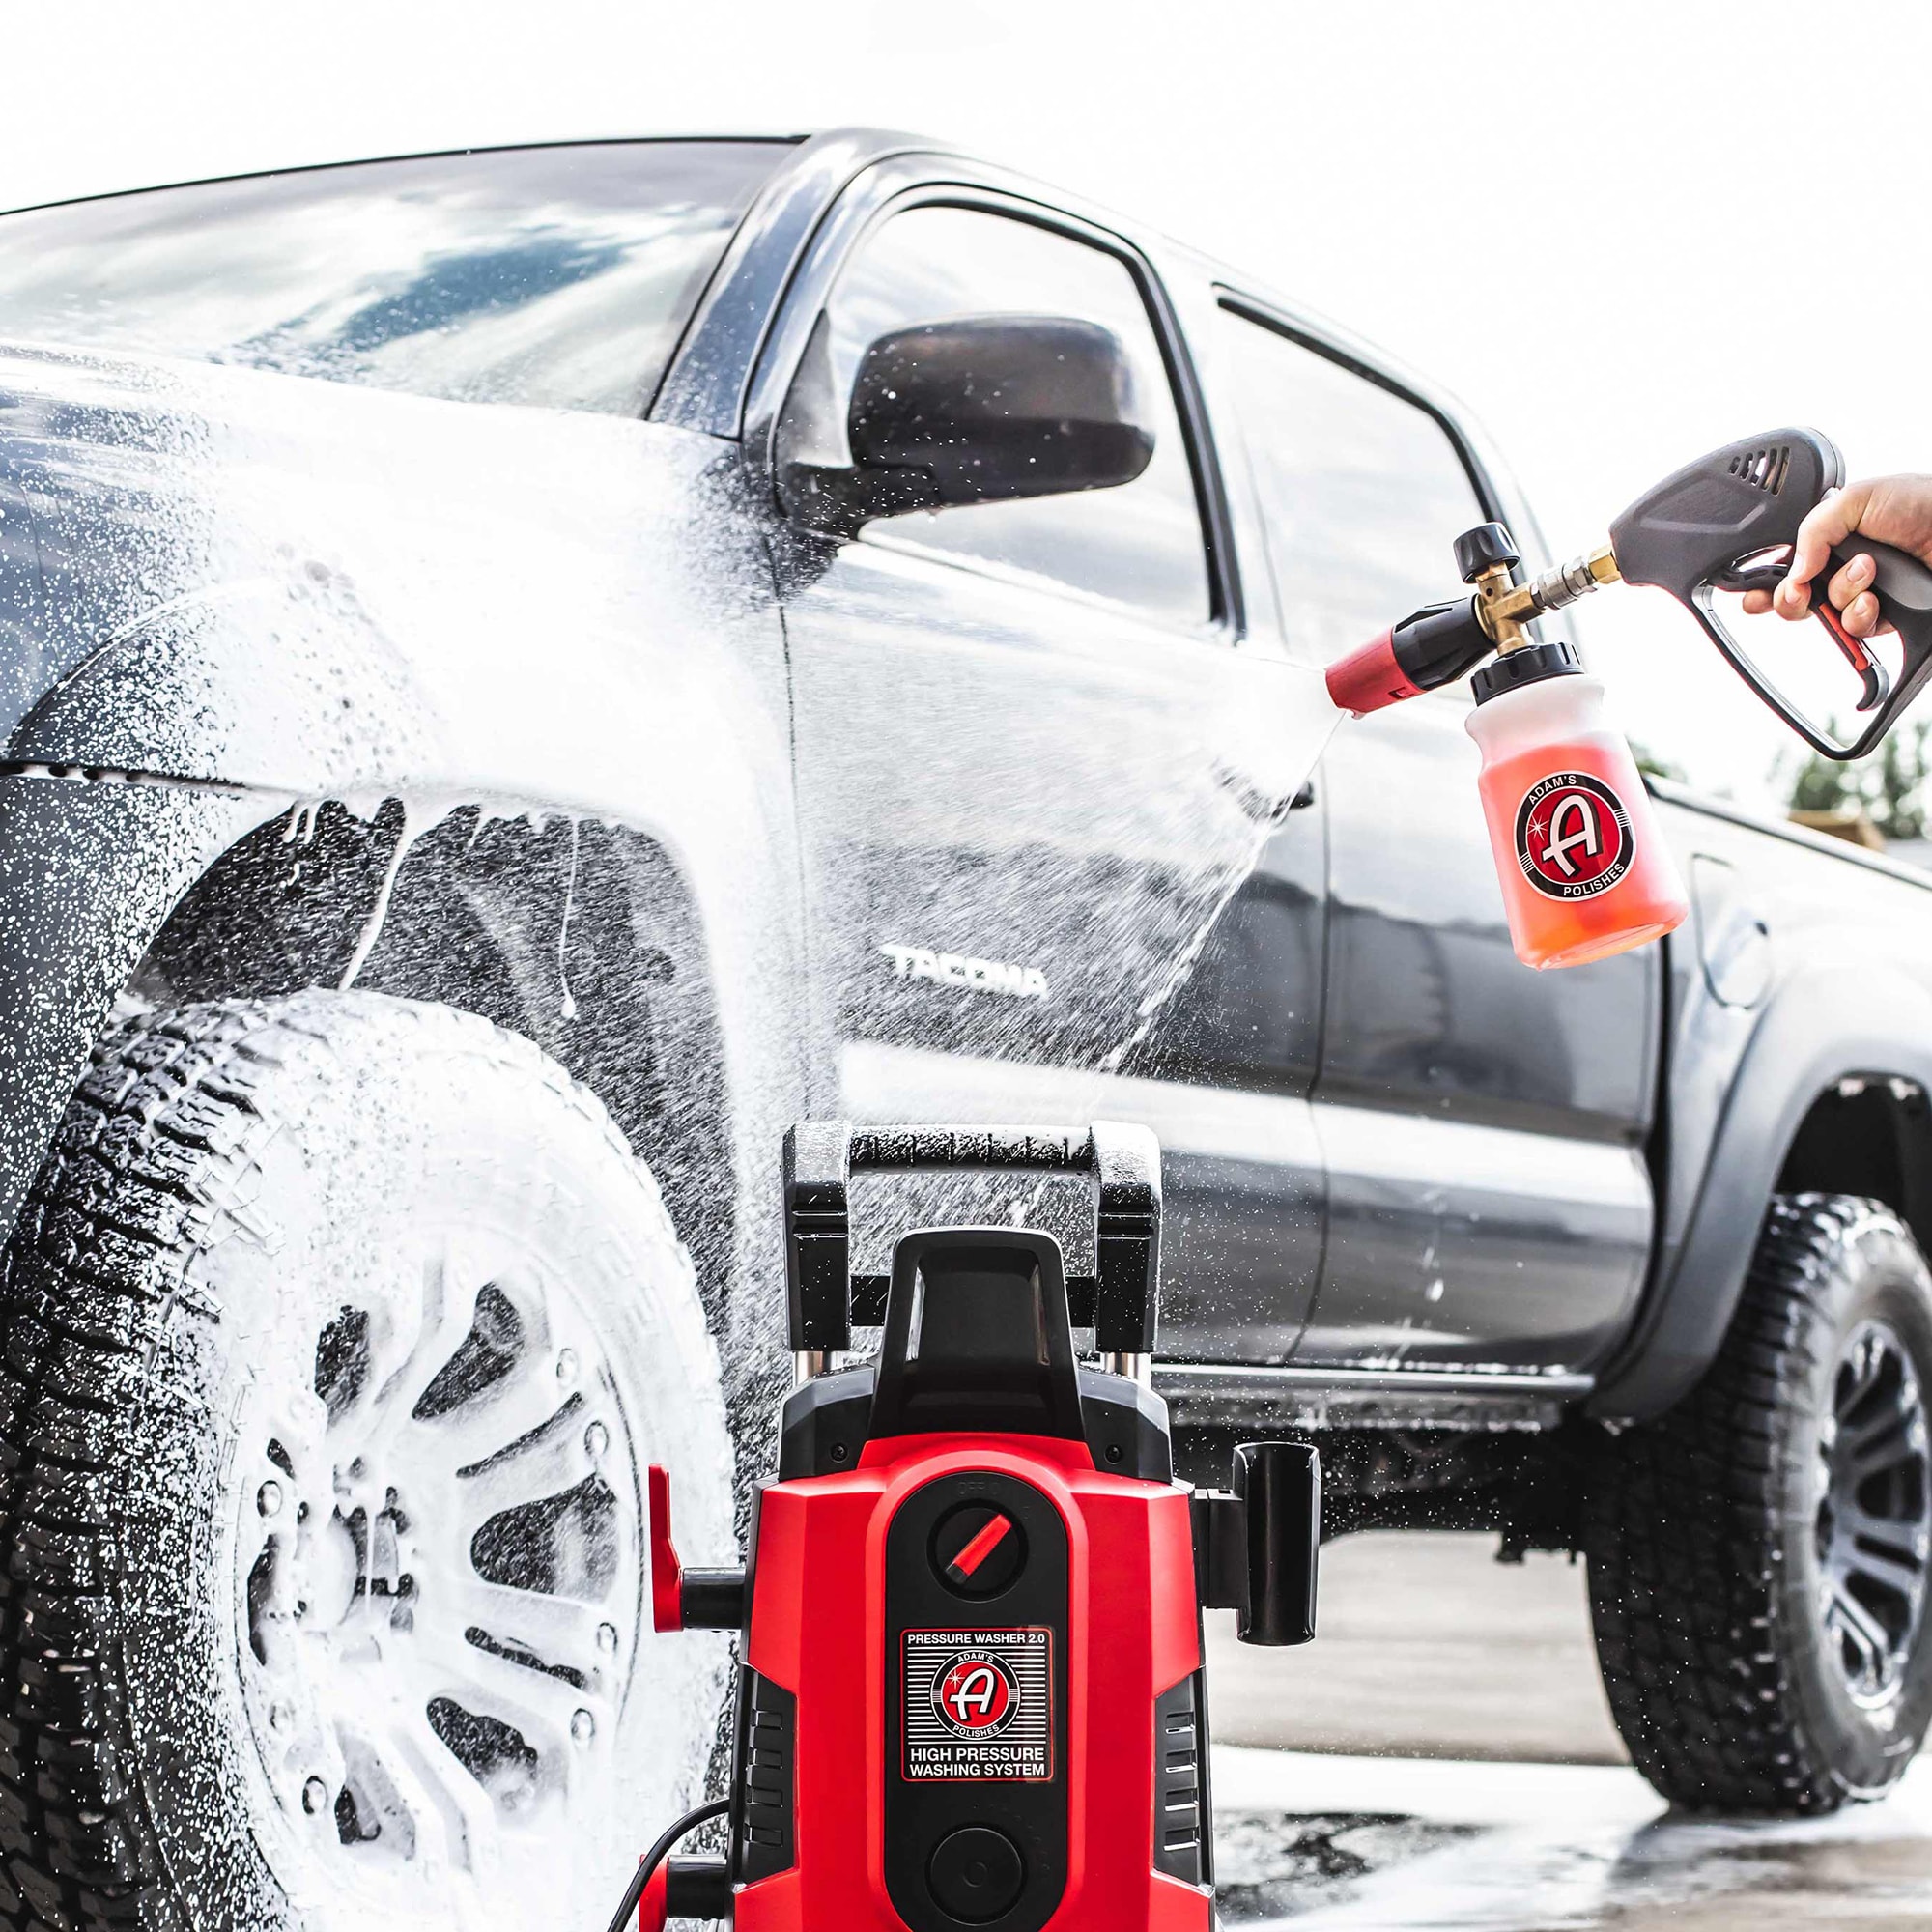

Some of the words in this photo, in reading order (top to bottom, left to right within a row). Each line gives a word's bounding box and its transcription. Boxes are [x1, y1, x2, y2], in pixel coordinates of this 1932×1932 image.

[1528, 775, 1577, 805] ADAM'S
[1563, 863, 1625, 896] POLISHES
[879, 944, 1049, 1000] TACOMA
[908, 1634, 972, 1644] PRESSURE
[974, 1634, 1026, 1644] WASHER
[1028, 1634, 1045, 1644] 2.0
[957, 1652, 994, 1663] ADAM'S
[952, 1724, 1000, 1738] POLISHES
[910, 1747, 952, 1762] HIGH
[956, 1747, 1044, 1761] PRESSURE
[910, 1764, 980, 1776] WASHING
[984, 1763, 1045, 1776] SYSTEM
